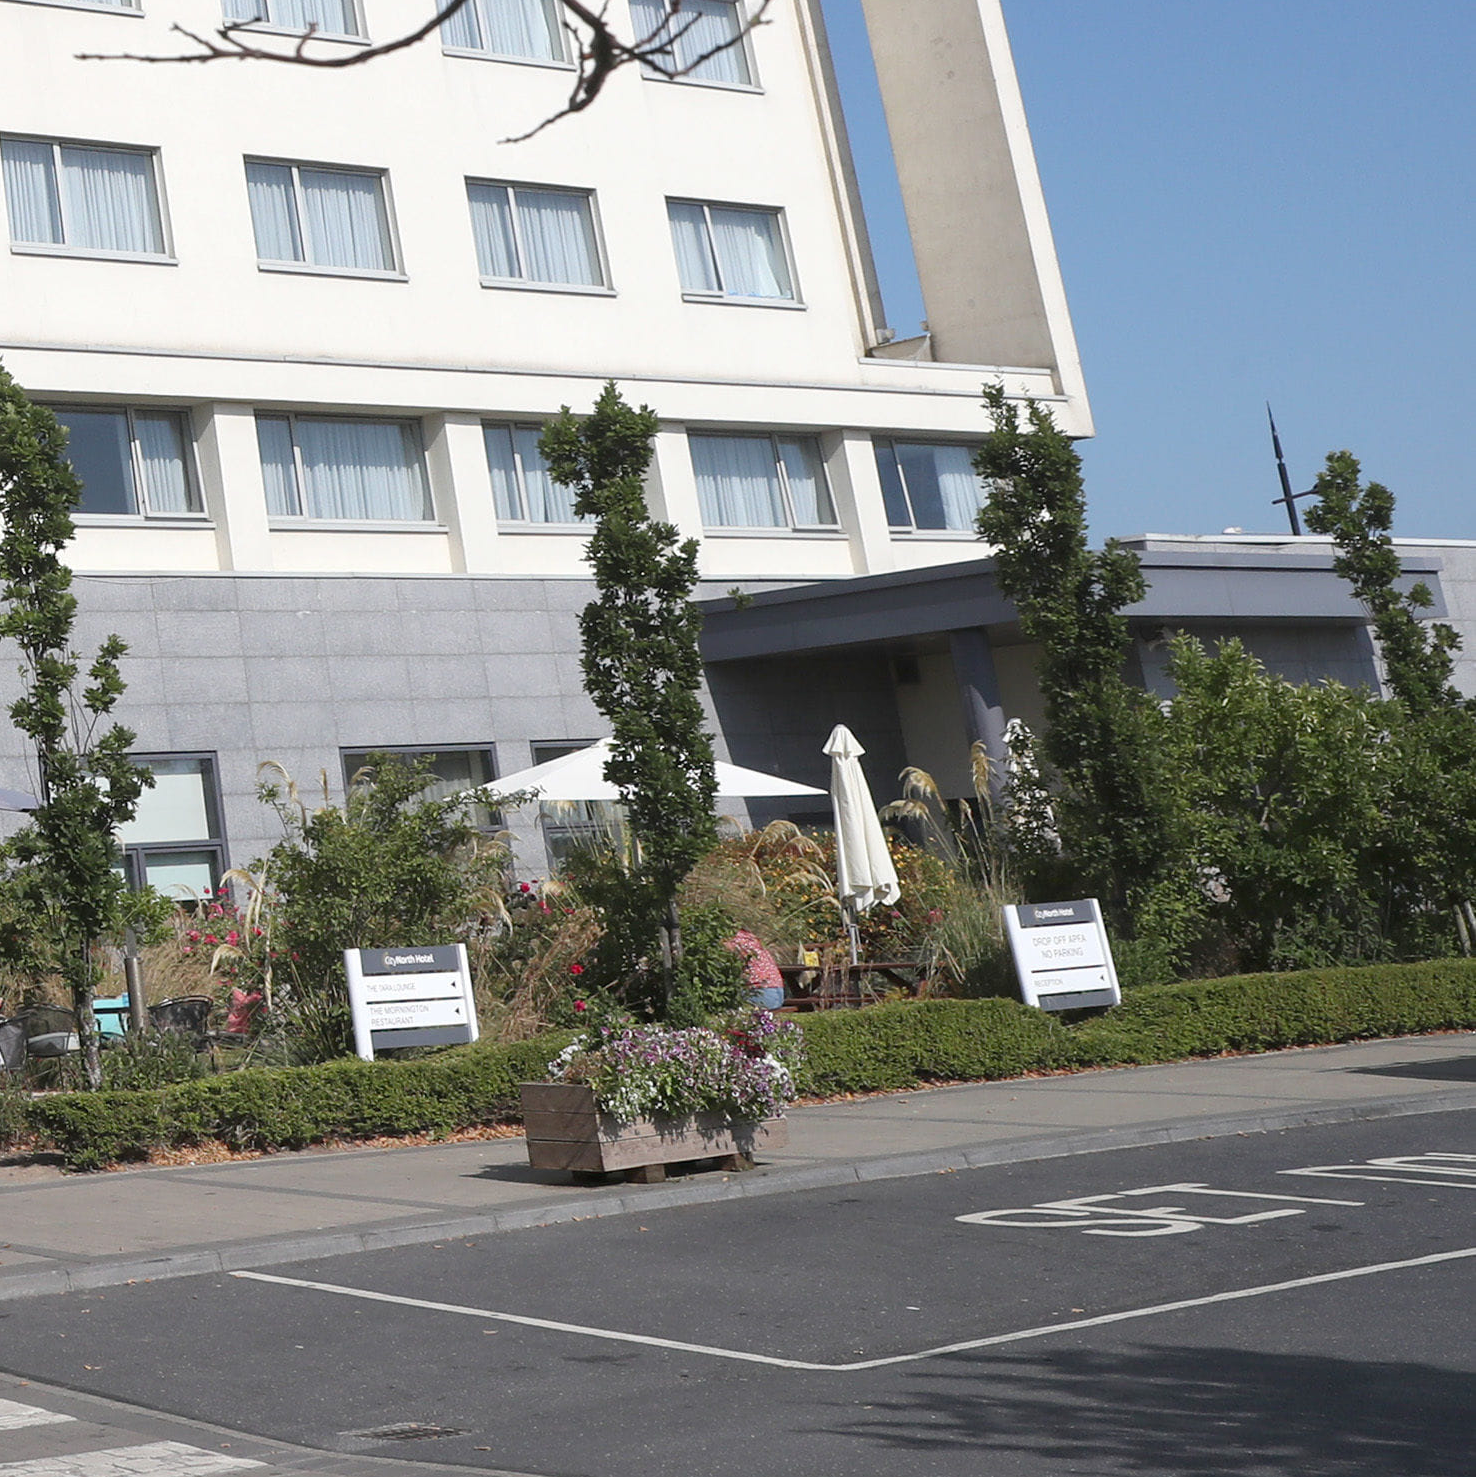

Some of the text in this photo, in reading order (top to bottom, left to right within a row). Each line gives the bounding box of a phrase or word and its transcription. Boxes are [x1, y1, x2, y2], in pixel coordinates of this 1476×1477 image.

[1032, 933, 1087, 946] DROP OFF AREA
[415, 953, 435, 964] Hotel
[1041, 947, 1084, 959] NO PARKING
[370, 1004, 430, 1015] THE MORNINGTON
[370, 1016, 414, 1026] RESTAURANT
[953, 1182, 1366, 1238] SET
